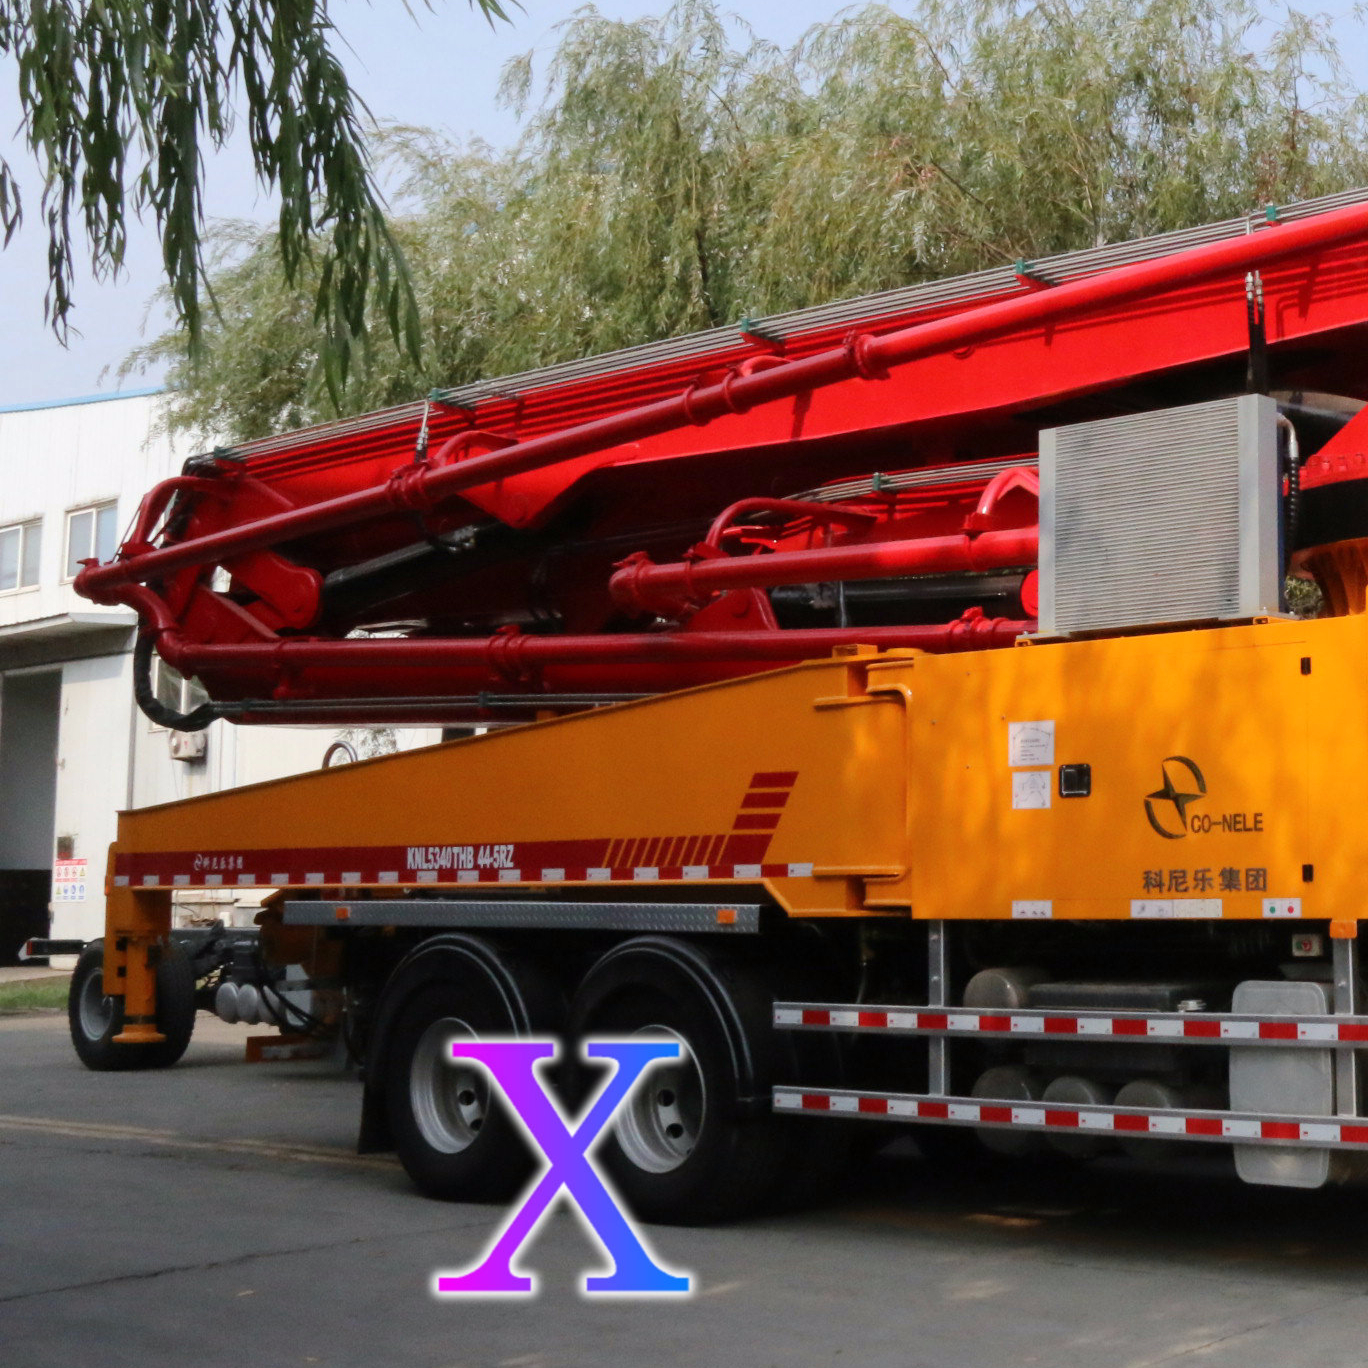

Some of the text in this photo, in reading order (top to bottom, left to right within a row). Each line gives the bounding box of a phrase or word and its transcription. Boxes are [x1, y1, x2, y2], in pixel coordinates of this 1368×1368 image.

[1190, 813, 1263, 833] CO-NELE
[407, 845, 514, 869] KNL5340THB 44-5RZ
[1142, 867, 1267, 893] 科尼乐集团
